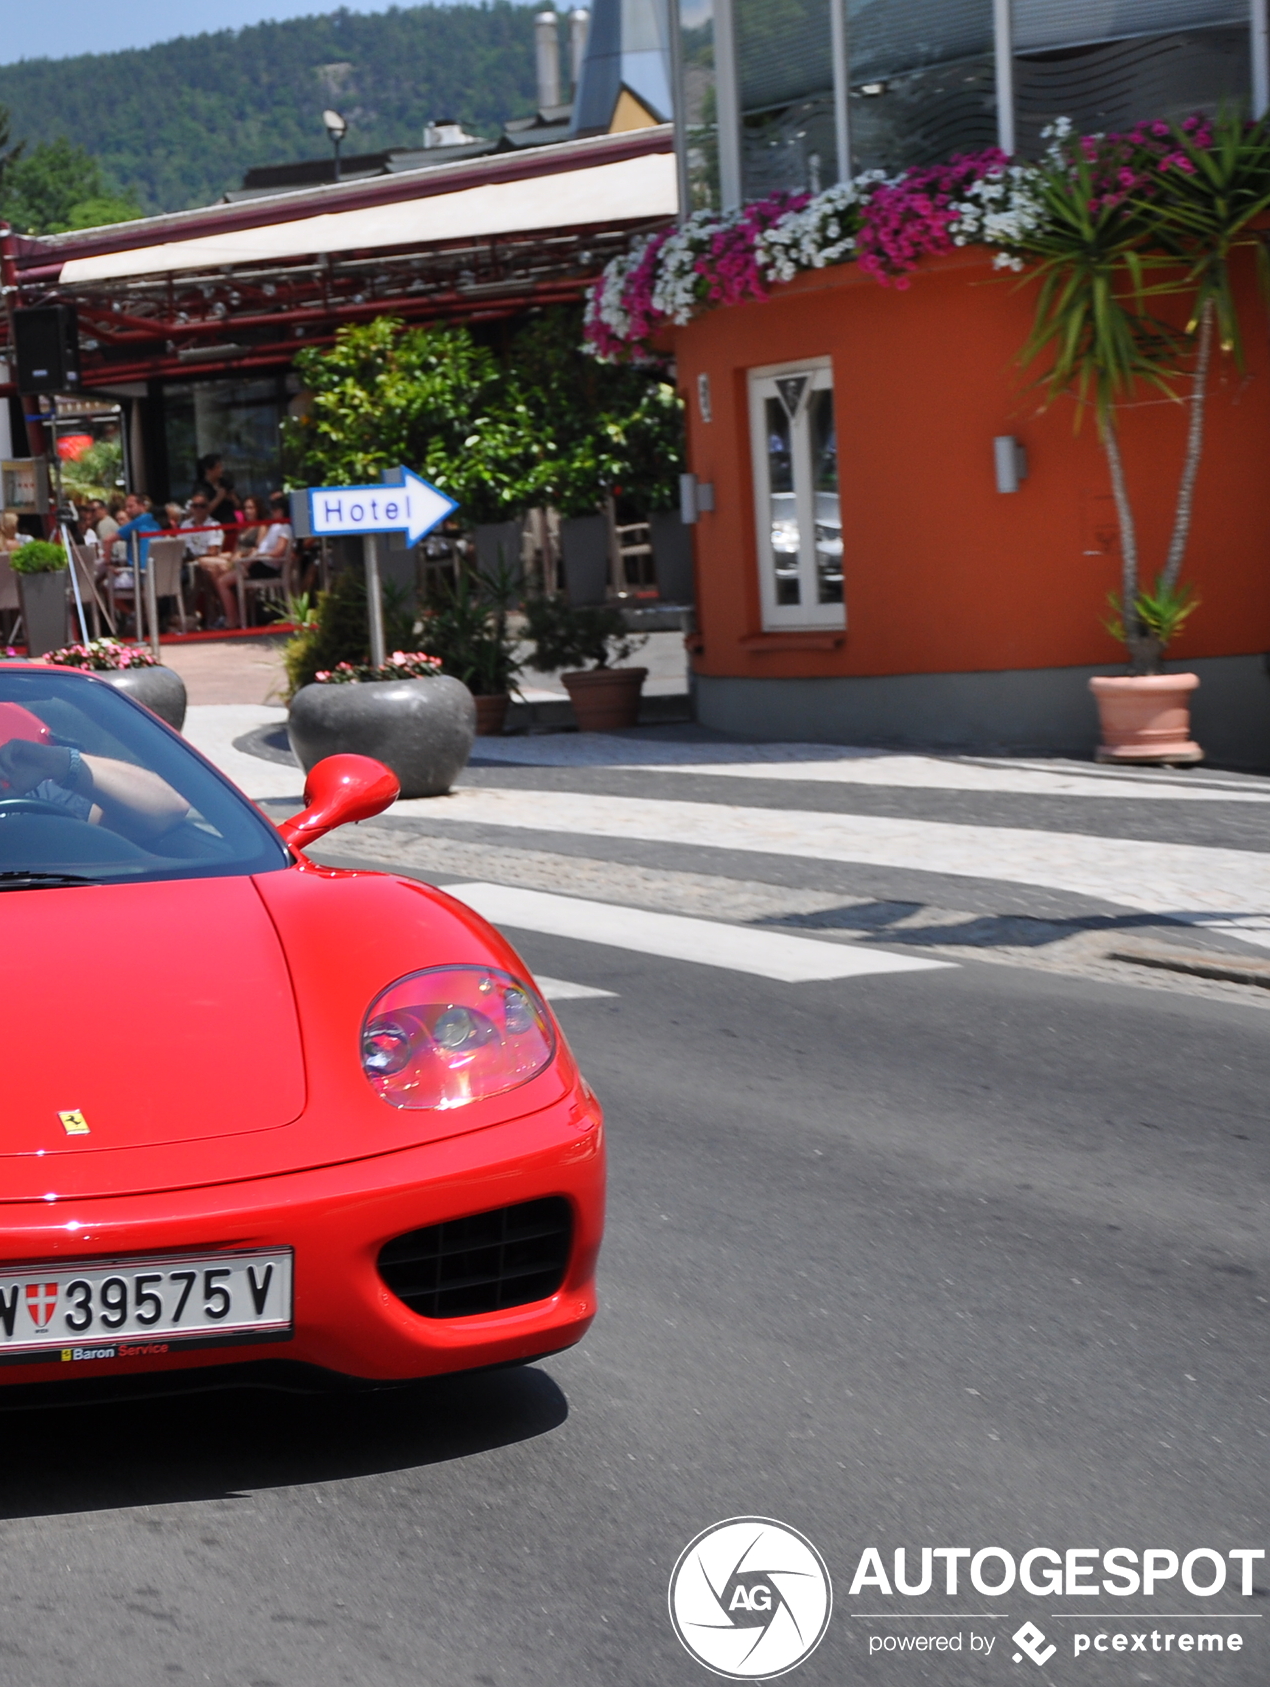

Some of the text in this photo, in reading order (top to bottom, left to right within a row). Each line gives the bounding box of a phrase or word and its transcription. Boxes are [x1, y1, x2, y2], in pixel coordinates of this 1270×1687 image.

[324, 495, 411, 522] Hotel
[64, 1268, 232, 1332] 39575
[246, 1261, 274, 1316] V
[72, 1344, 169, 1361] Baron Service
